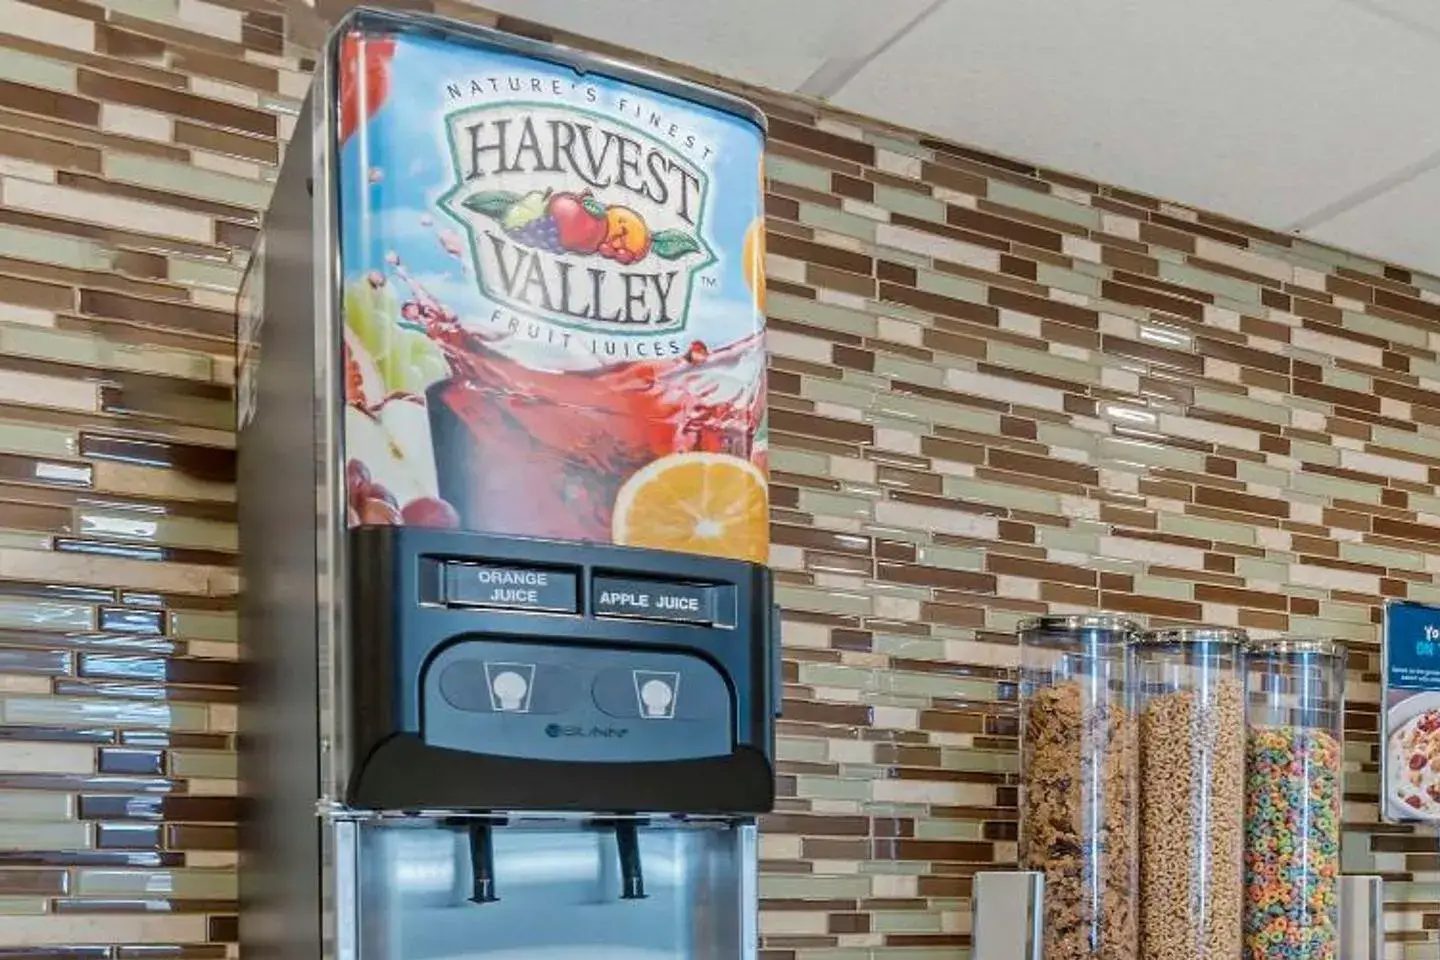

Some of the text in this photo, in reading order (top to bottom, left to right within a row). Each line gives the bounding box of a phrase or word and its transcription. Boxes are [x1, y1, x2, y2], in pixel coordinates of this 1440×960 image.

[446, 76, 714, 159] NATURE'S FINEST
[464, 116, 702, 226] HARVEST
[483, 229, 680, 326] VALLEY
[489, 308, 681, 358] FRUIT JUICES
[478, 570, 548, 587] ORANGE
[490, 587, 538, 603] JUICE
[599, 591, 699, 611] APPLE JUICE
[1416, 640, 1434, 657] ON
